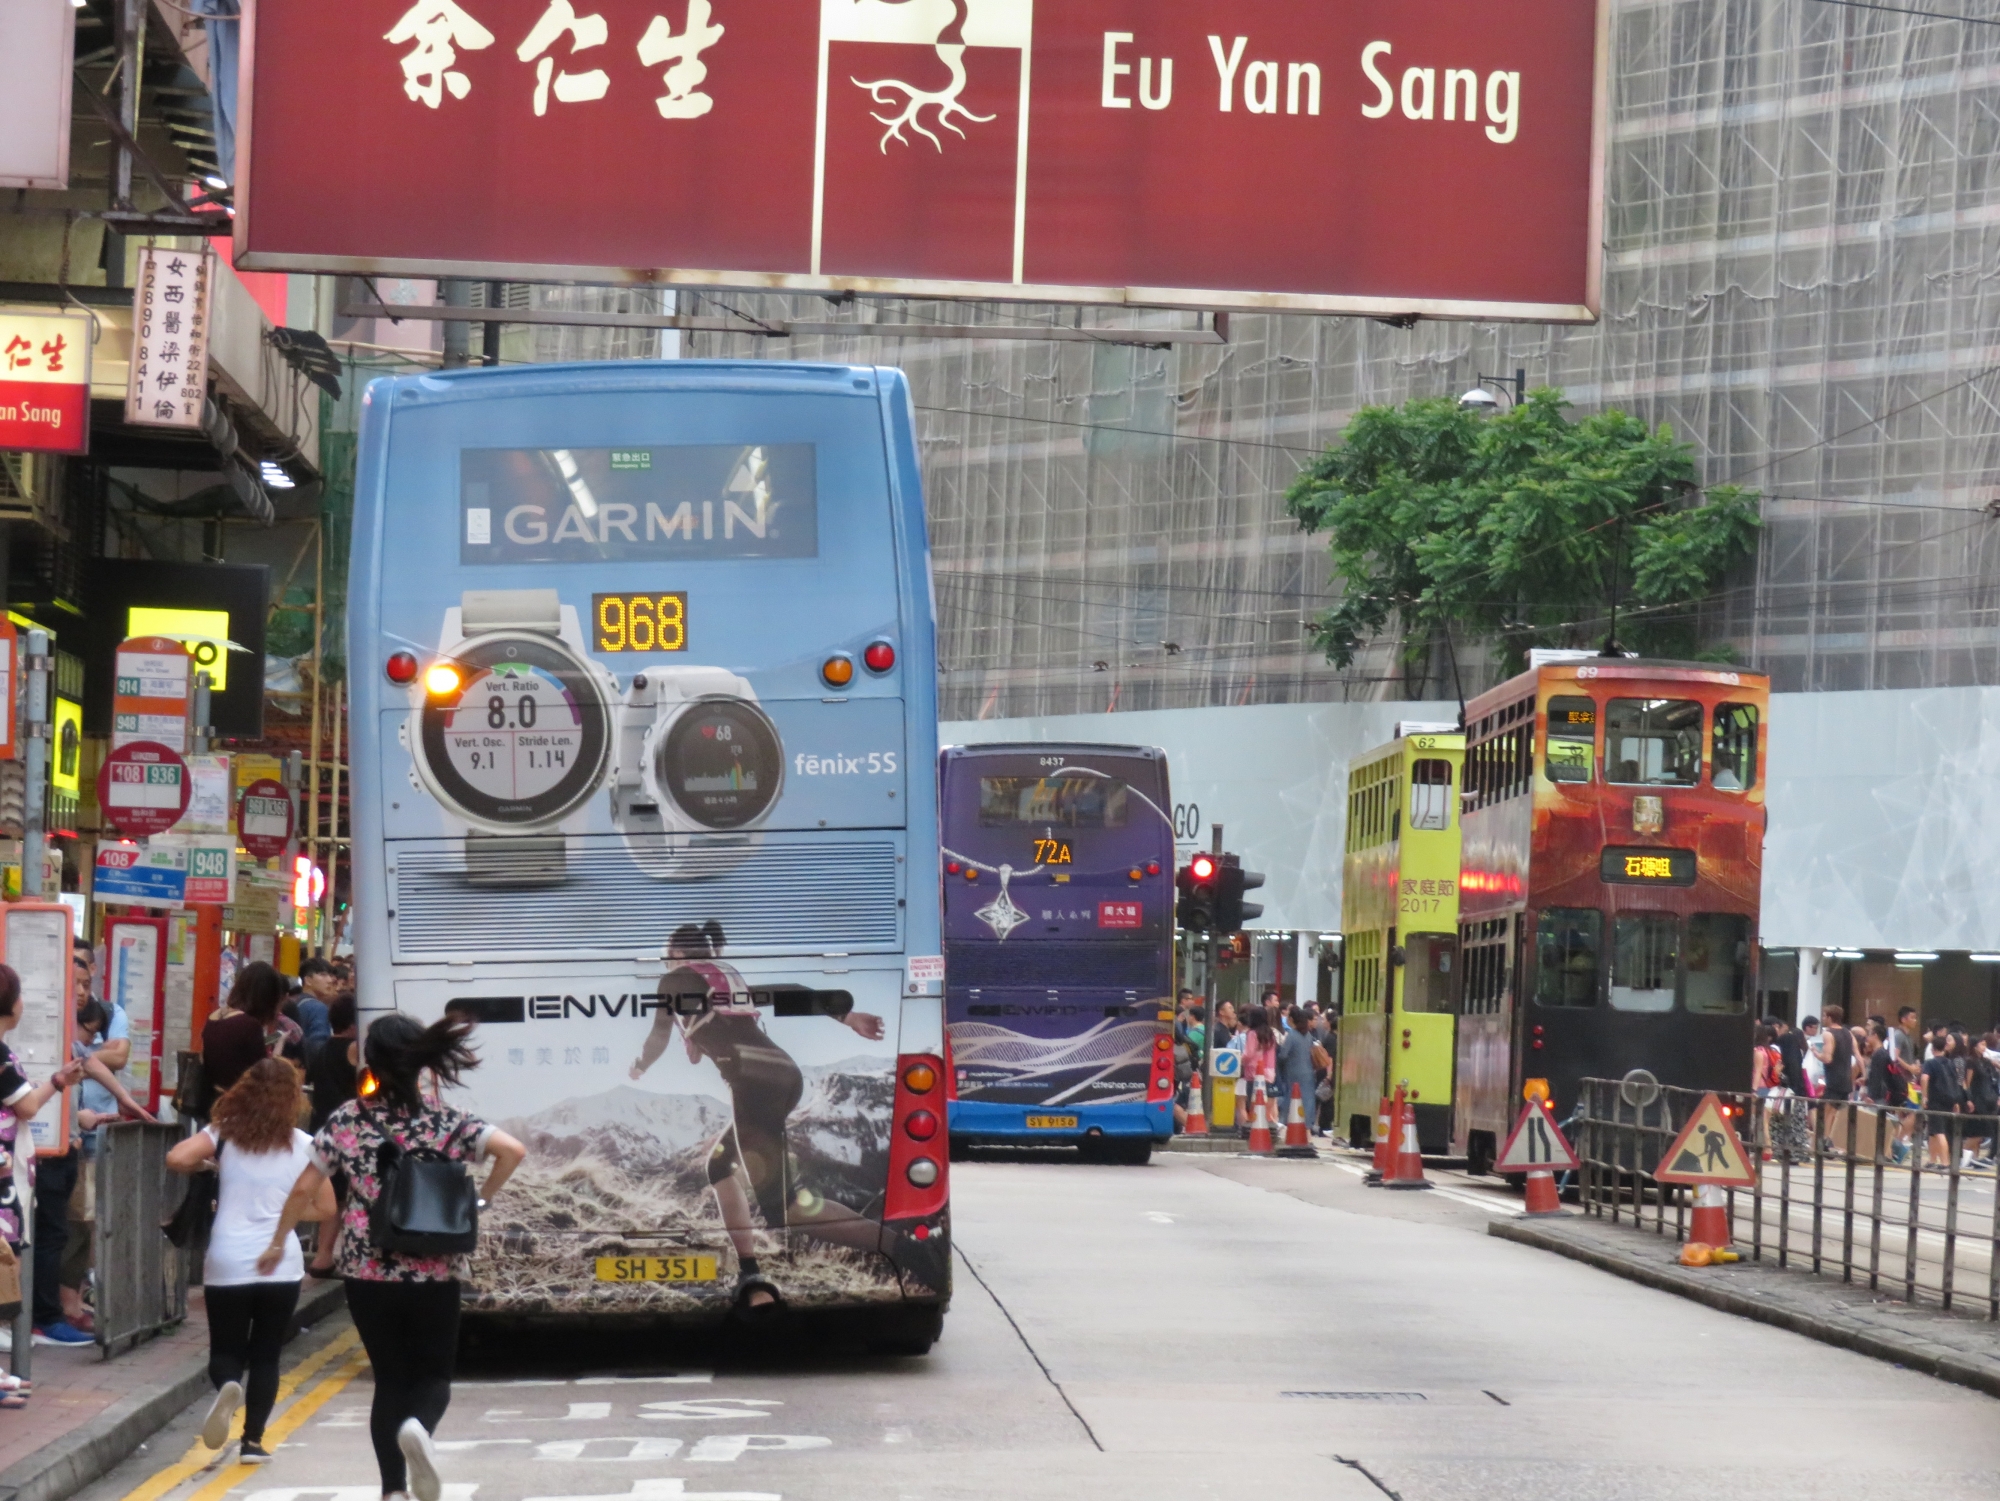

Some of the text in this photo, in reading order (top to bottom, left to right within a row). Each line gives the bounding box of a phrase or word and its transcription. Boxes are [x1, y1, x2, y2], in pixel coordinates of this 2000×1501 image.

[383, 0, 725, 118] 余仁生
[1101, 31, 1520, 144] Eu Yan Sang
[135, 274, 156, 411] 2890 8411
[4, 333, 67, 372] 仁生
[21, 401, 61, 429] Sang
[504, 500, 767, 545] GARMIN
[599, 596, 684, 652] 968
[1576, 667, 1598, 678] 69
[118, 679, 138, 694] 914
[486, 681, 540, 692] Vert. Ratio
[487, 694, 537, 729] 8.0
[116, 715, 137, 730] 948
[454, 736, 506, 748] Vert. Osc.
[518, 735, 574, 746] Stride Len.
[716, 725, 732, 741] 68
[1418, 737, 1436, 749] 62
[471, 752, 495, 770] 9.1
[529, 750, 565, 769] 1.14
[868, 752, 897, 774] 5S
[1040, 757, 1064, 767] 8437
[116, 766, 176, 784] 108 936
[104, 851, 129, 866] 108
[1034, 839, 1071, 863] 72A
[196, 852, 224, 875] 948
[1402, 879, 1454, 897] 家庭節
[1400, 898, 1440, 912] 2017
[615, 1259, 699, 1279] SH 351
